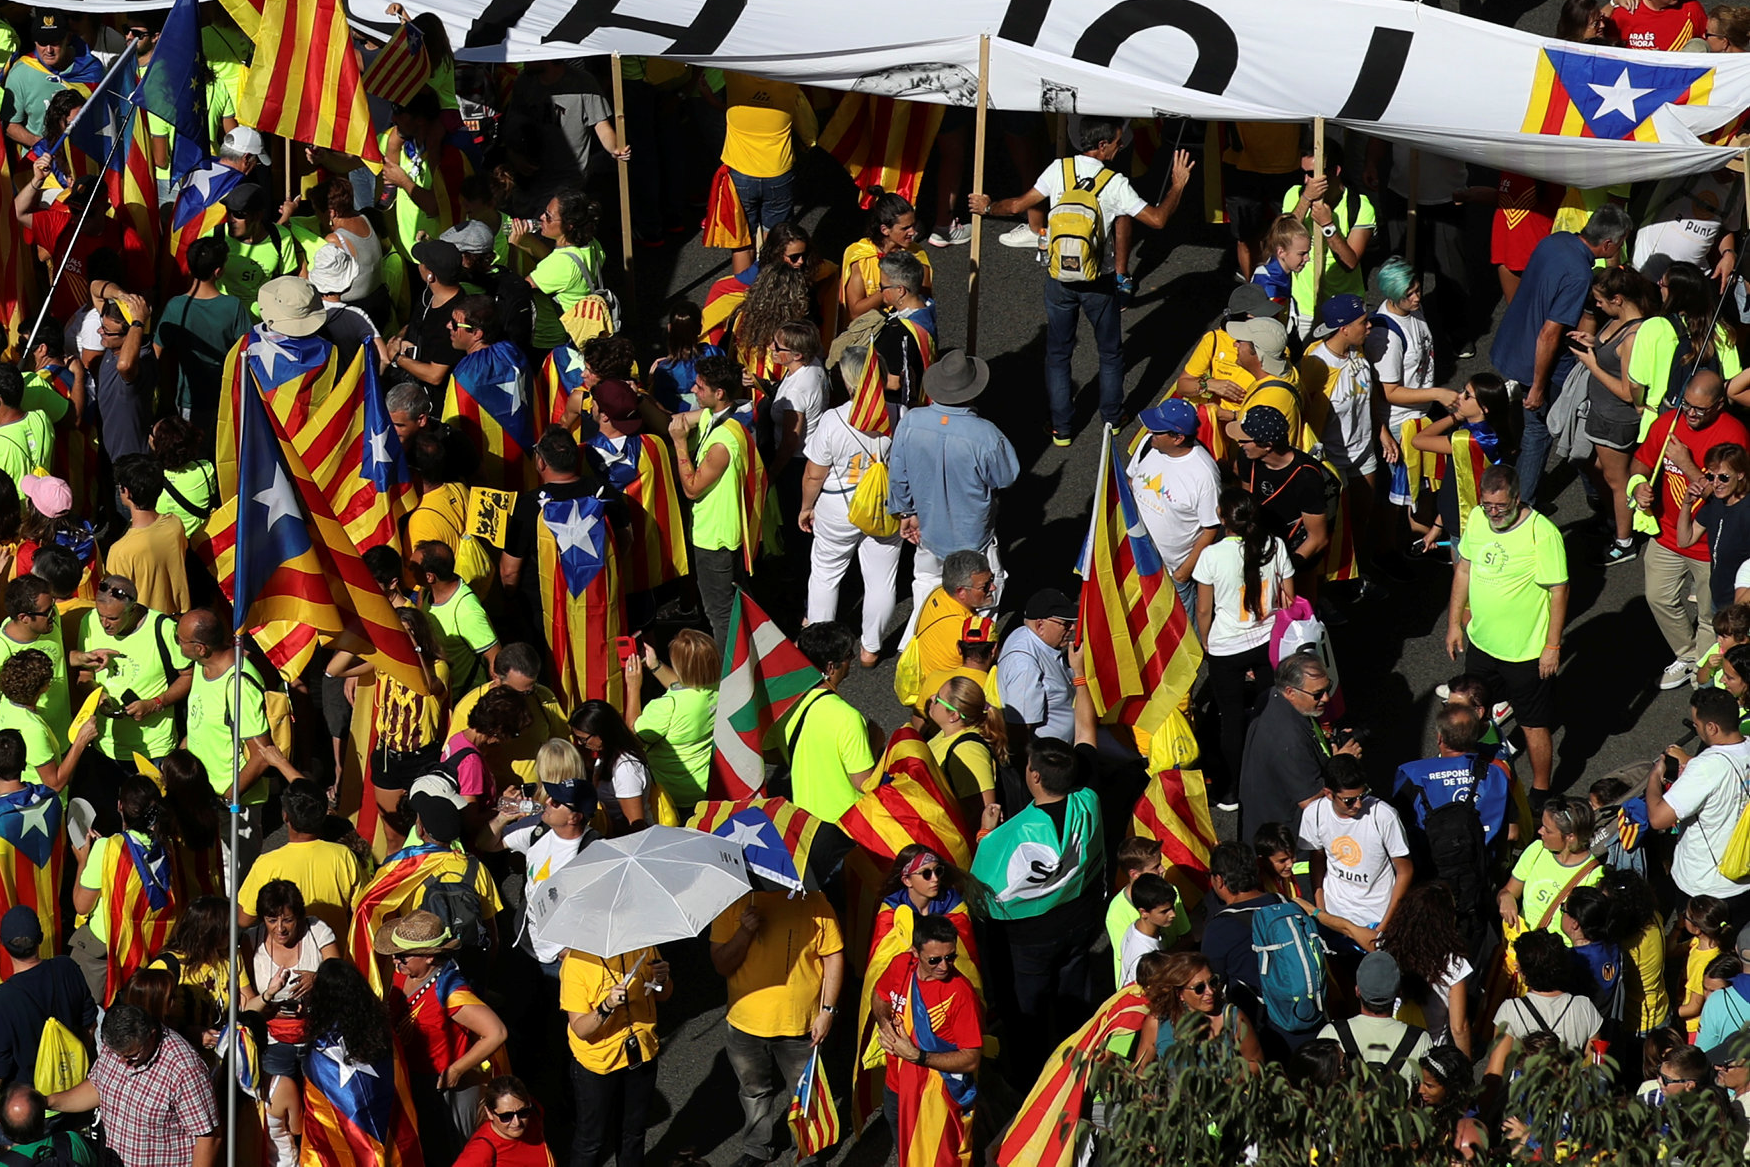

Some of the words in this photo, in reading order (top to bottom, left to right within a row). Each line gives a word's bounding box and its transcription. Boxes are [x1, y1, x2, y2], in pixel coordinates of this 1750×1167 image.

[1644, 31, 1655, 40] ÉS
[1685, 220, 1711, 237] punt
[1429, 769, 1470, 780] RESPONS
[1443, 778, 1454, 786] DE
